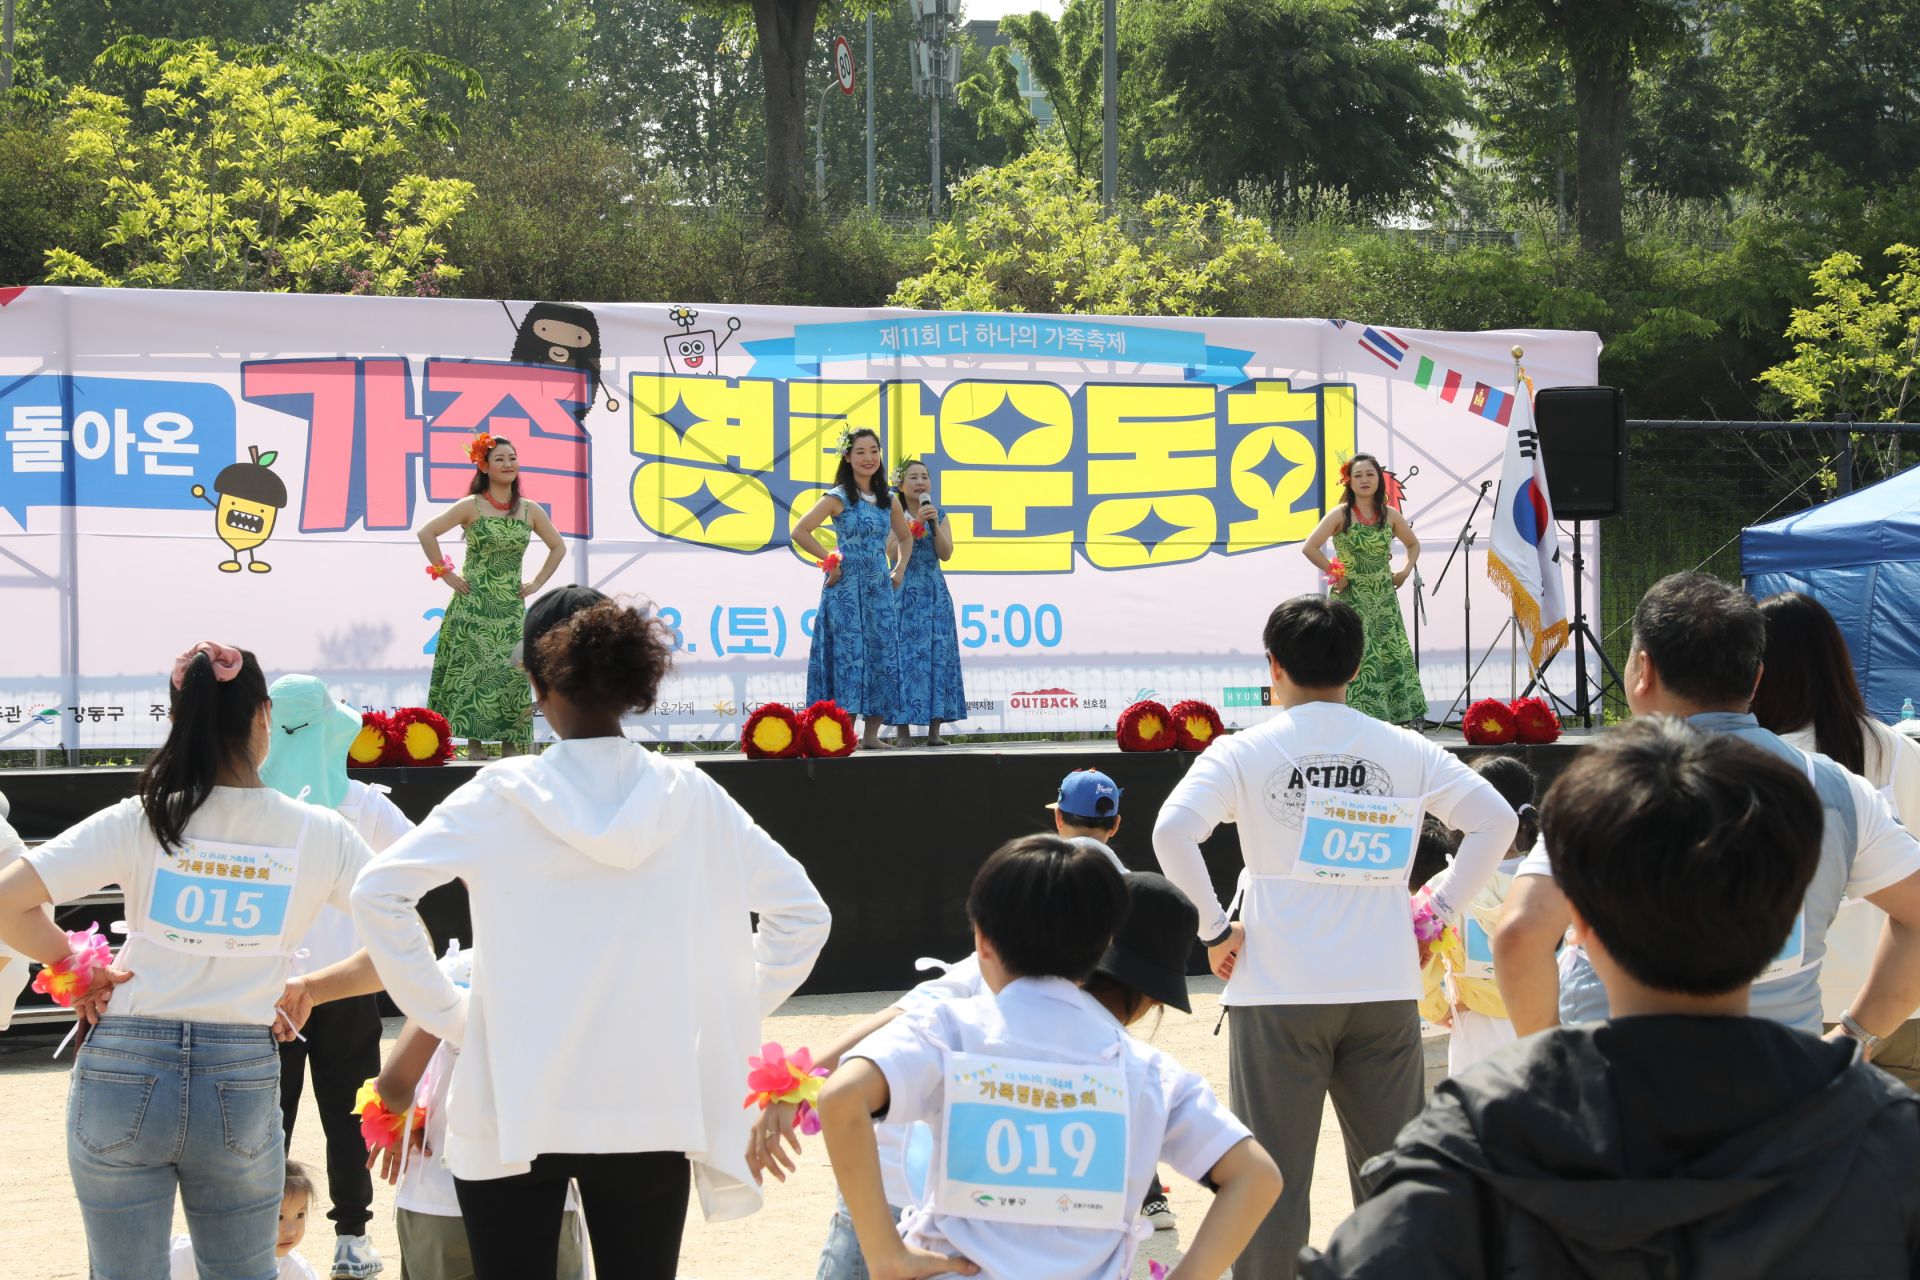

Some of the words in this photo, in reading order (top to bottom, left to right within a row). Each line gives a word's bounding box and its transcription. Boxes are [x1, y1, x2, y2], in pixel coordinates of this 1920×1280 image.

[839, 53, 851, 79] 80
[880, 322, 941, 350] 제11회
[947, 322, 968, 347] 다
[975, 323, 1037, 348] 하나의
[1045, 327, 1126, 354] 가족축제
[5, 404, 200, 477] 돌아온
[241, 356, 593, 540] 가족
[709, 603, 788, 658] (토)
[965, 700, 994, 711] 일역지점
[1010, 697, 1079, 709] OUTBACK
[1083, 699, 1107, 709] 천호점
[1227, 691, 1280, 702] HYUNDA
[67, 705, 125, 723] 강동구
[149, 703, 172, 722] 주
[1322, 828, 1391, 864] 055
[175, 885, 264, 929] 015
[985, 1118, 1097, 1178] 019
